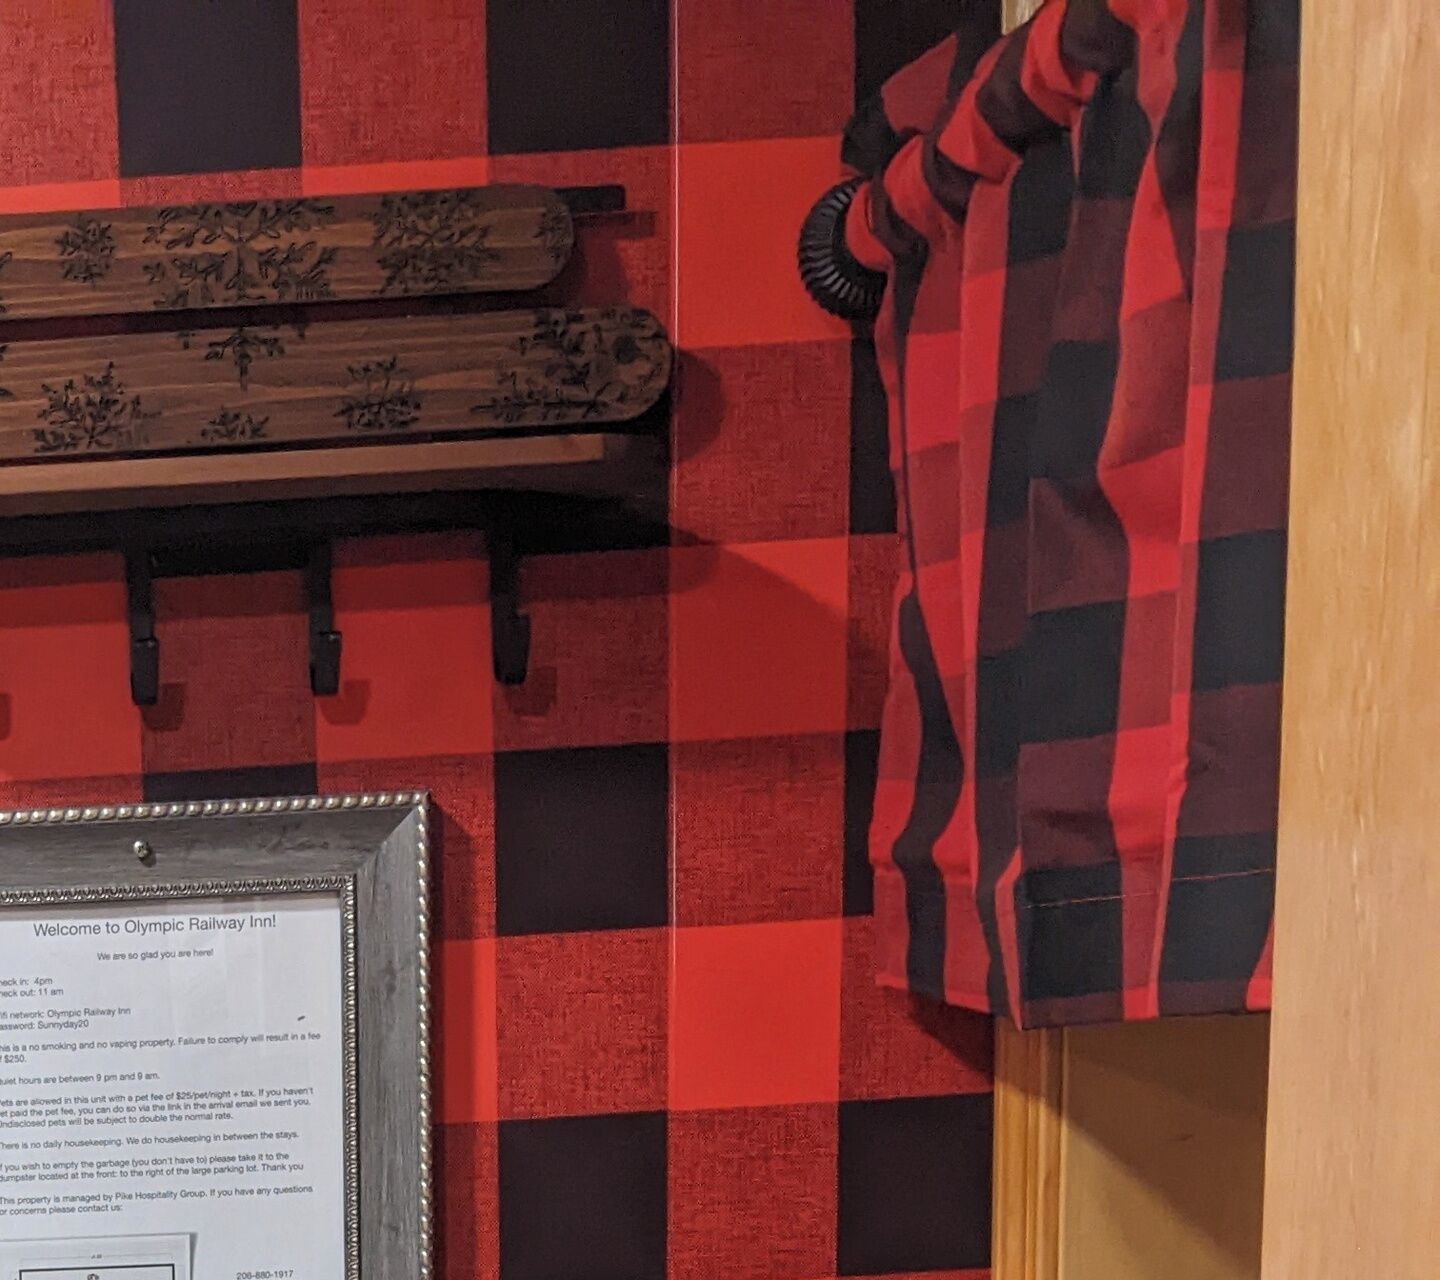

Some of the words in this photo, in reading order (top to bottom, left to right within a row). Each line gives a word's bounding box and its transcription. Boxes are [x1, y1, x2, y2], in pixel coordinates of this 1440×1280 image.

[34, 922, 101, 937] Welcome
[106, 922, 120, 934] to
[125, 918, 184, 936] Olympic
[189, 916, 245, 931] Railway
[250, 915, 276, 928] Inn!
[97, 952, 111, 960] We
[141, 951, 159, 961] glad
[160, 951, 176, 960] you
[193, 949, 213, 957] here!
[20, 978, 29, 986] in:
[34, 977, 53, 986] 4pm
[20, 989, 36, 997] out:
[10, 1011, 45, 1019] network:
[47, 1009, 82, 1019] Olympic
[84, 1007, 116, 1016] Railway
[118, 1007, 131, 1015] Inn
[38, 1019, 89, 1030] Sunnyday20
[12, 1044, 20, 1052] is
[41, 1042, 77, 1052] smoking
[79, 1041, 95, 1049] and
[110, 1041, 137, 1050] vaping
[139, 1039, 175, 1048] property.
[178, 1036, 205, 1045] Failure
[218, 1036, 248, 1045] comply
[266, 1034, 289, 1042] result
[308, 1032, 321, 1040] fee
[4, 1054, 26, 1063] $250.
[59, 1075, 94, 1083] between
[104, 1075, 117, 1083] pm
[30, 1097, 62, 1106] allowed
[74, 1096, 89, 1104] this
[135, 1095, 149, 1103] pet
[151, 1093, 164, 1101] fee
[166, 1092, 174, 1101] of
[176, 1090, 231, 1101] $25/pet/night
[266, 1090, 281, 1098] you
[43, 1140, 62, 1150] daily
[64, 1138, 124, 1148] housekeeping.
[126, 1137, 140, 1145] We
[141, 1136, 152, 1144] do
[154, 1135, 212, 1145] housekeeping
[223, 1133, 258, 1141] between
[260, 1131, 274, 1139] the
[276, 1131, 298, 1140] stays.
[0, 1196, 15, 1205] This
[17, 1196, 51, 1206] property
[54, 1195, 60, 1203] is
[62, 1195, 101, 1204] managed
[103, 1194, 113, 1203] by
[115, 1192, 133, 1200] Pike
[135, 1191, 178, 1200] Hospitality
[180, 1189, 207, 1198] Group.
[218, 1190, 233, 1198] you
[235, 1188, 254, 1196] have
[257, 1188, 271, 1196] any
[273, 1186, 313, 1194] questions
[49, 1206, 76, 1214] please
[78, 1204, 109, 1212] contact
